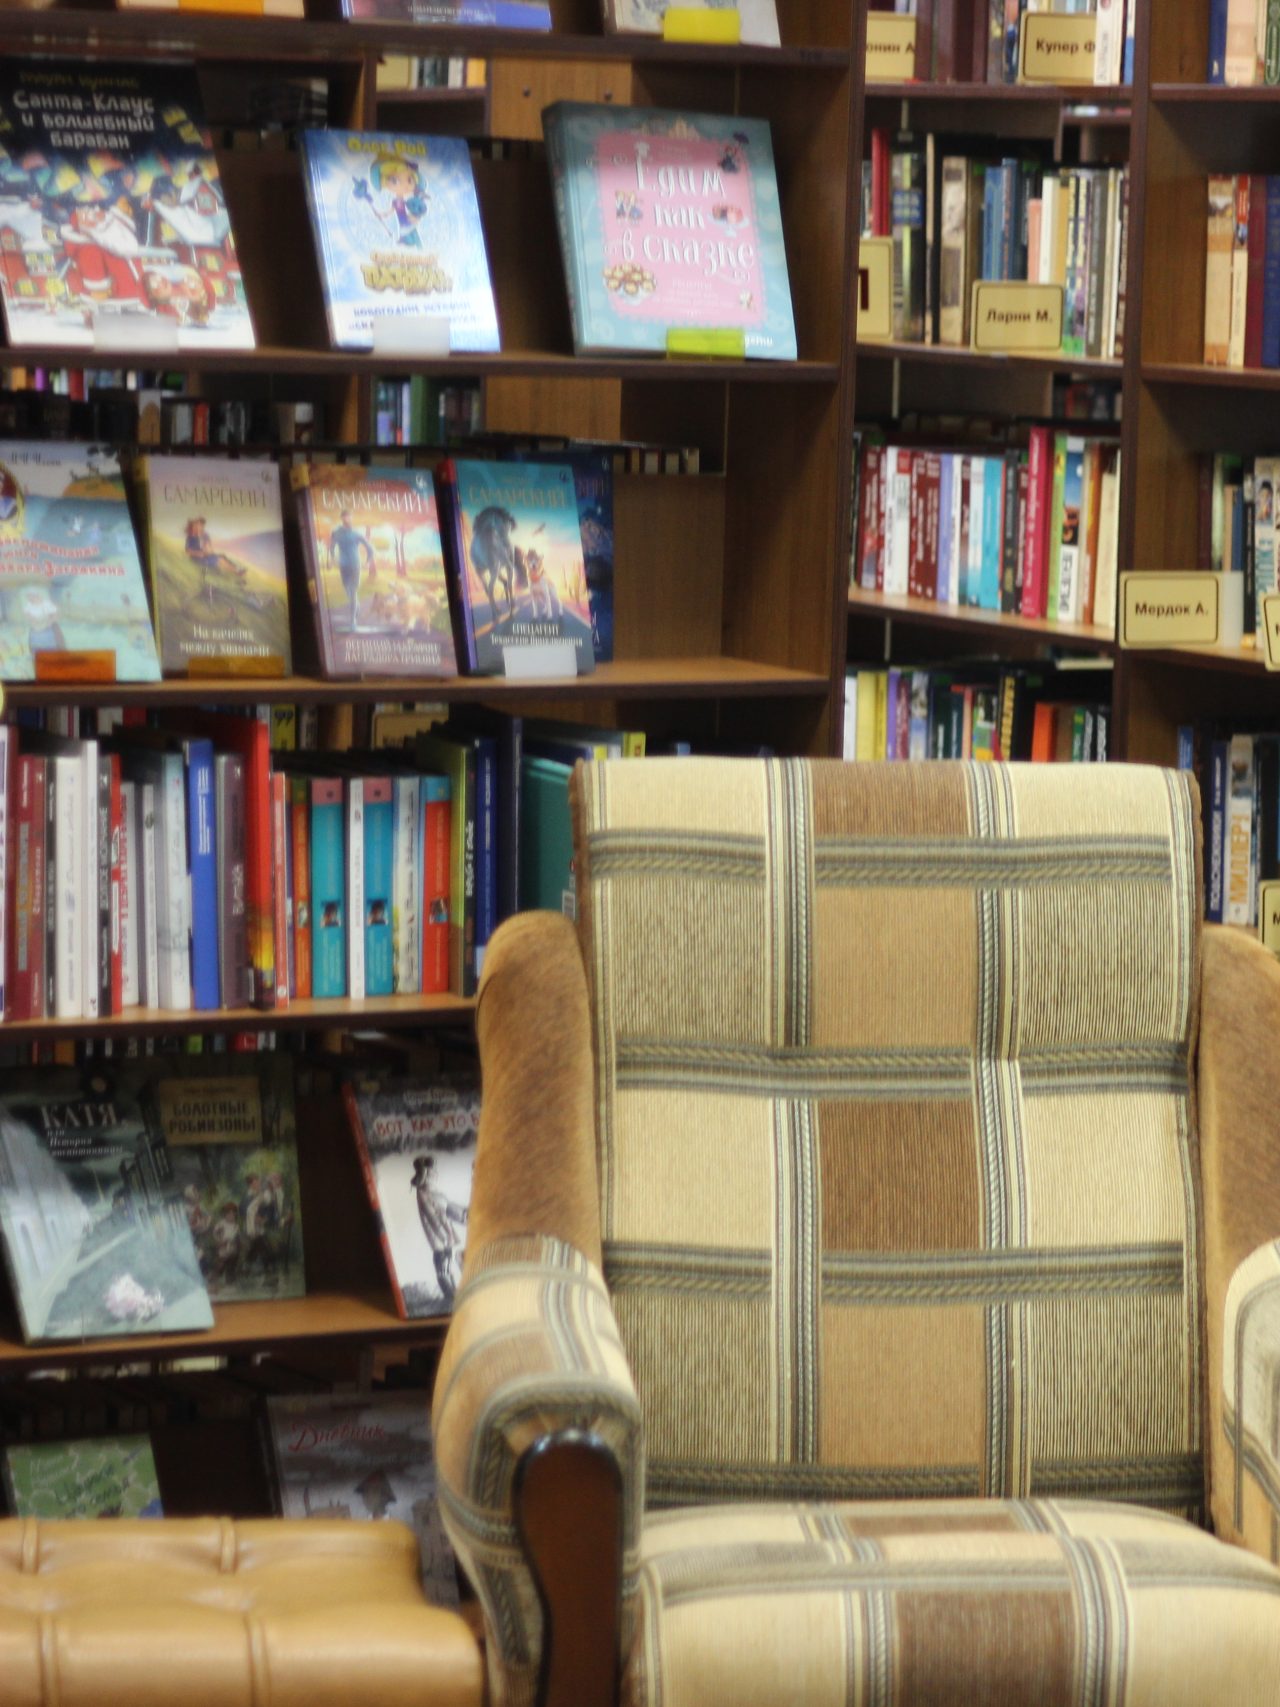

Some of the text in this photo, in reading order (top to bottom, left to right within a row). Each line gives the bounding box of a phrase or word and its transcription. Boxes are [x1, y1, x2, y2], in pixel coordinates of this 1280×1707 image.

[1035, 38, 1079, 56] Купер
[986, 308, 1031, 327] Ларни
[1134, 602, 1208, 618] Мердок А.
